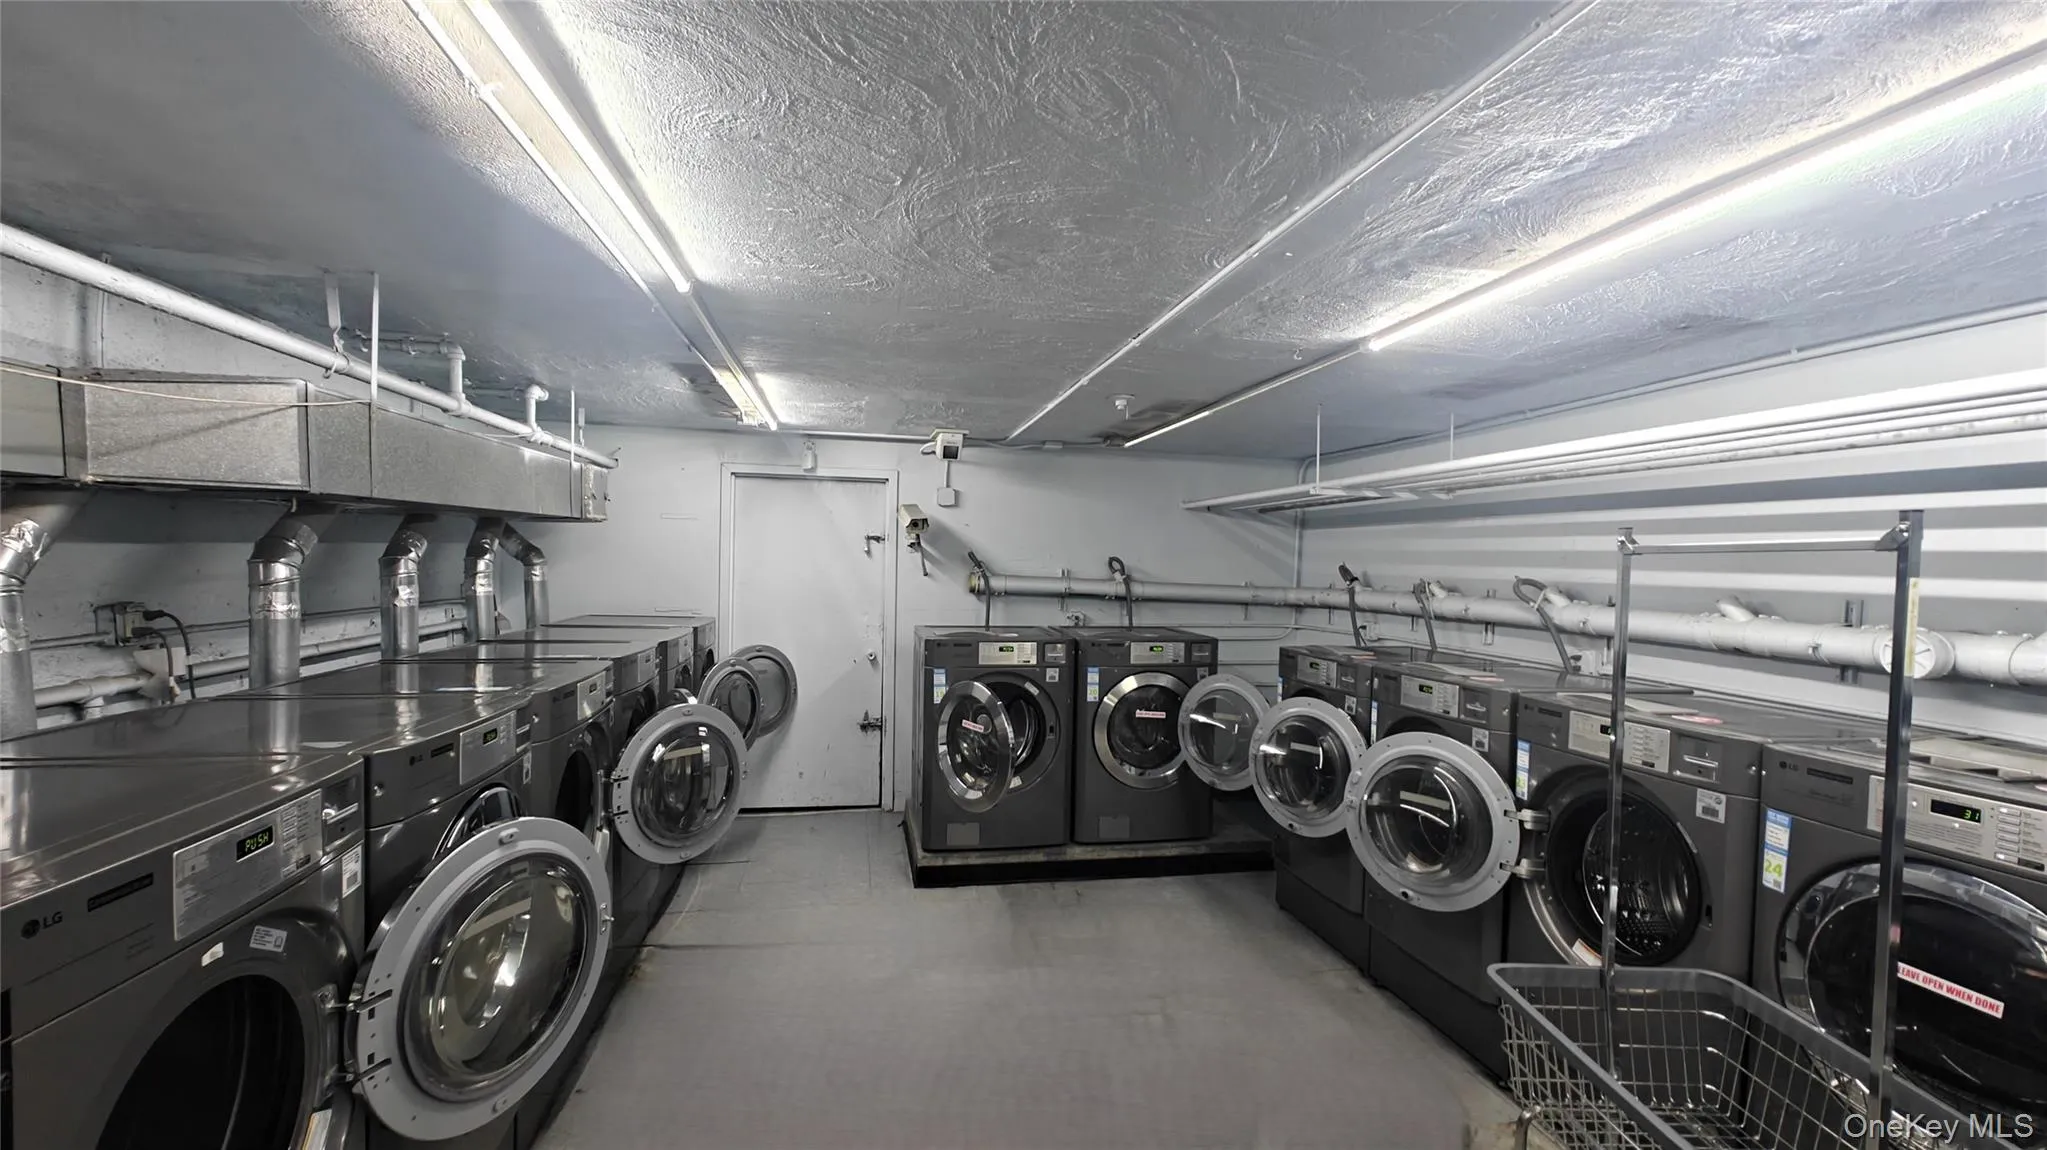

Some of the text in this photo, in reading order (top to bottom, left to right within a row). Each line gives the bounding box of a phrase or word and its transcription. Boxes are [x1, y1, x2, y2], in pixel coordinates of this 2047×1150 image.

[244, 831, 269, 852] PUSH
[1765, 858, 1783, 878] 24
[42, 911, 63, 929] LG
[1922, 974, 1944, 991] OPEN
[1946, 985, 1974, 1003] WHEN
[1975, 996, 2001, 1014] DONE
